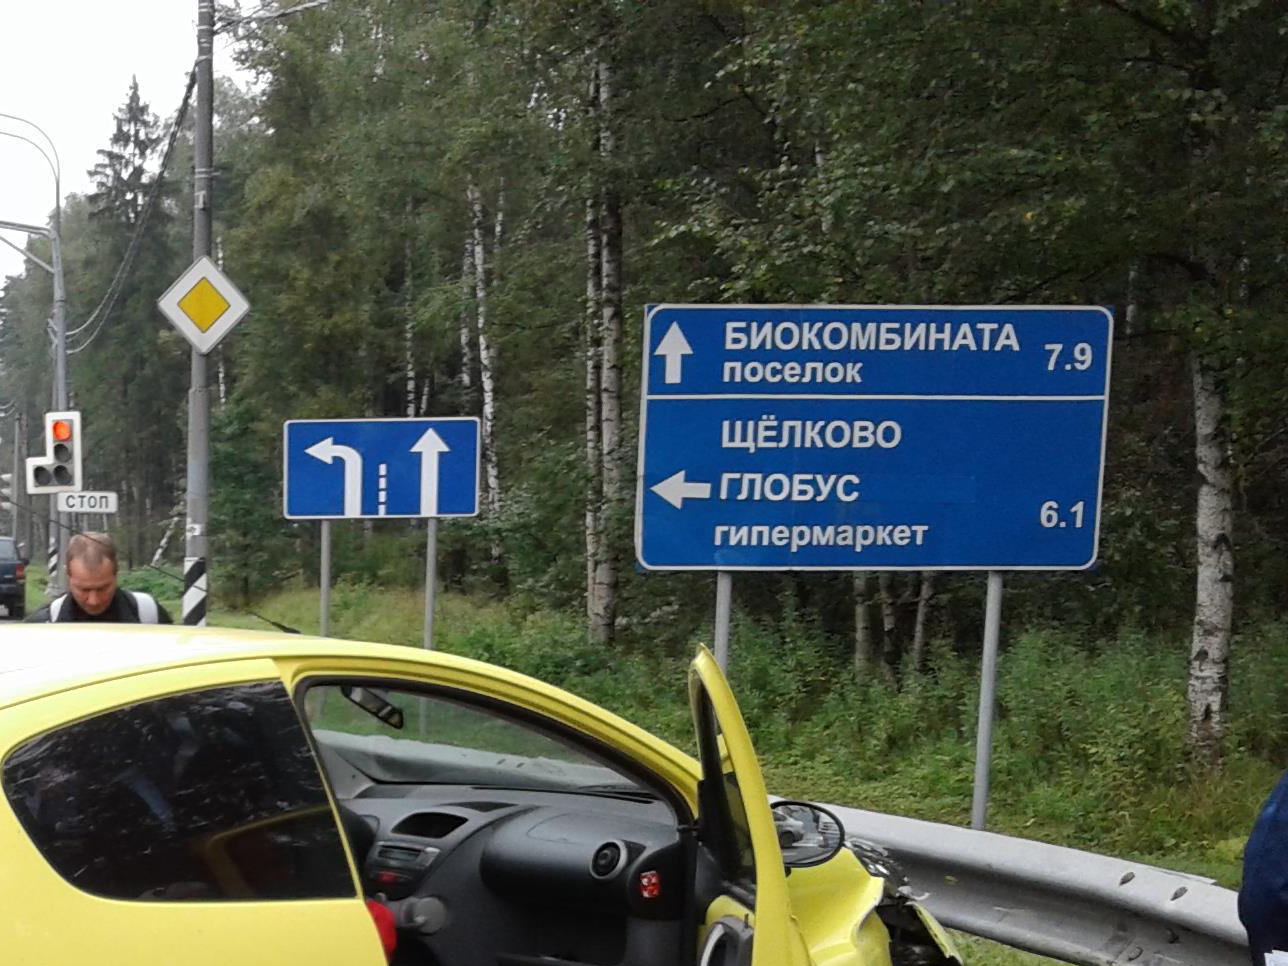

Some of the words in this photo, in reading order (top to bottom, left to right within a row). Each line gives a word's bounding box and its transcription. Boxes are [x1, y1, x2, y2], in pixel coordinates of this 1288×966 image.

[724, 321, 1020, 351] БИОКОМБИНАТА
[1044, 342, 1093, 371] 7.9
[722, 361, 863, 383] поселок
[721, 414, 903, 453] ЩЁЛКОВО
[719, 472, 860, 502] ГЛОБУС
[65, 495, 109, 509] СТОП
[1040, 500, 1084, 528] 6.1
[714, 524, 929, 552] гипермаркет
